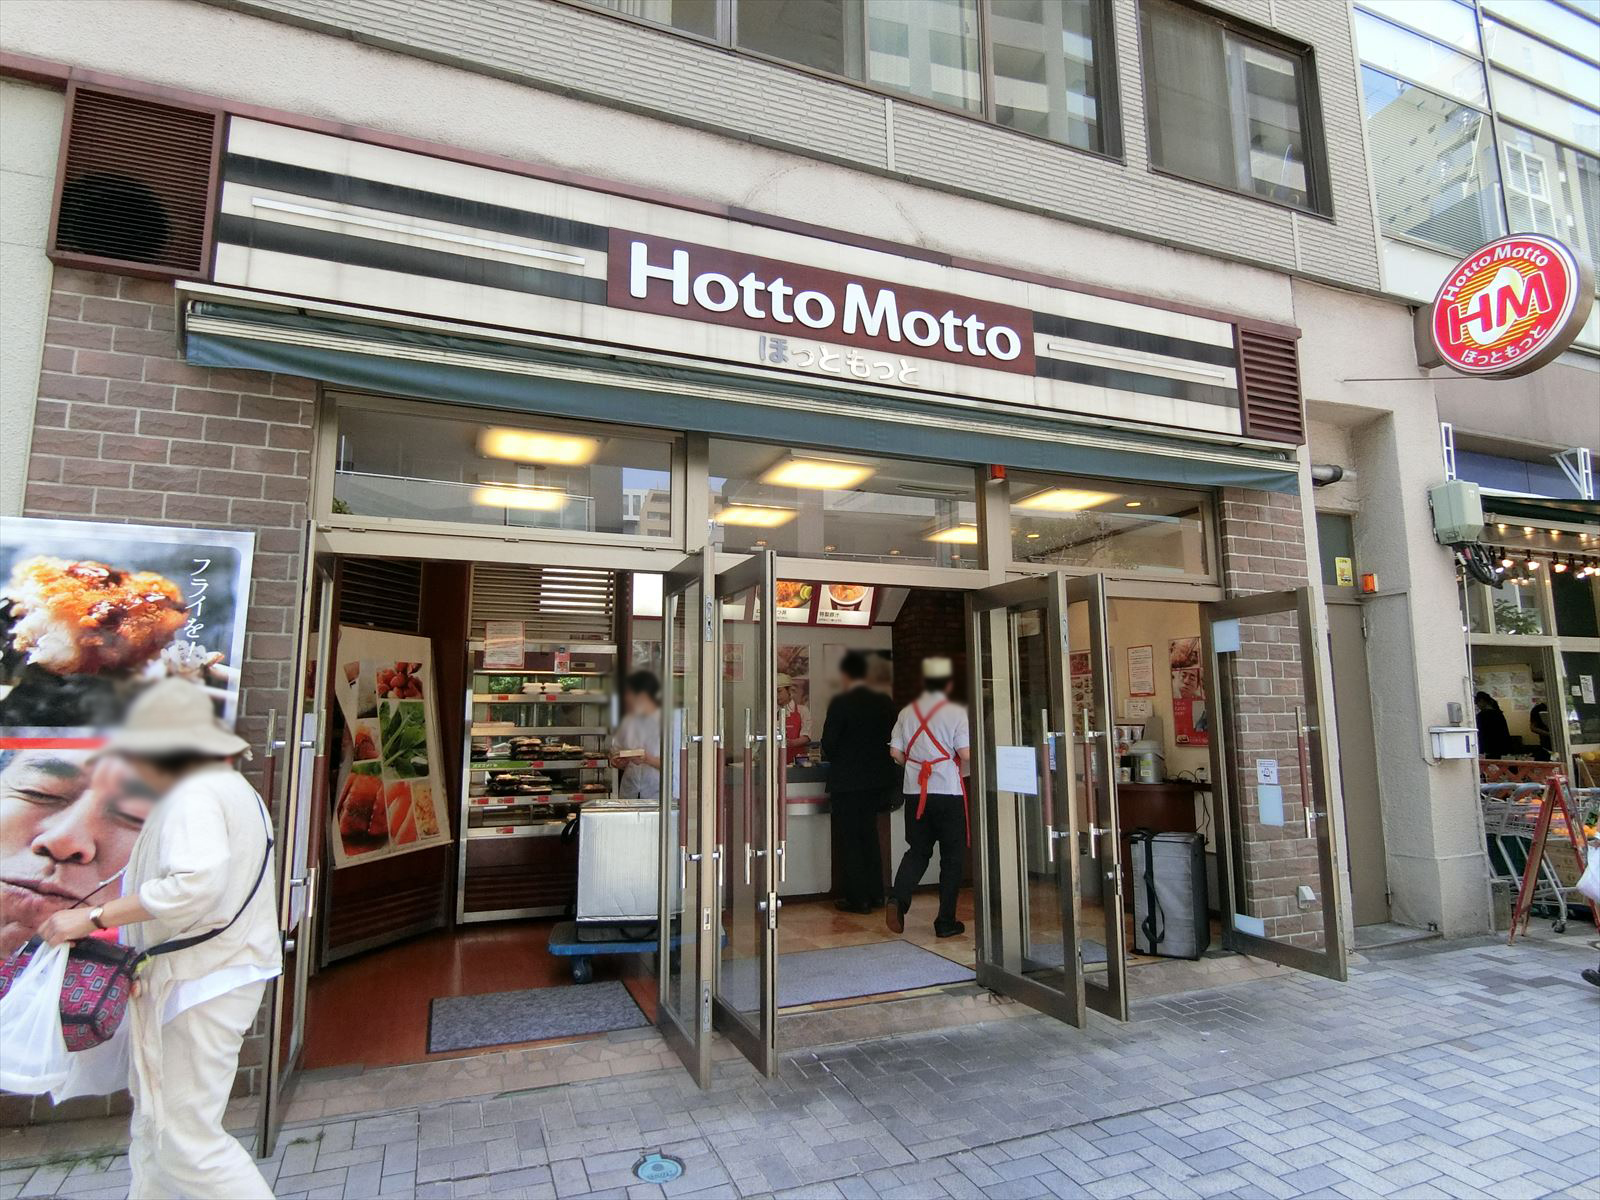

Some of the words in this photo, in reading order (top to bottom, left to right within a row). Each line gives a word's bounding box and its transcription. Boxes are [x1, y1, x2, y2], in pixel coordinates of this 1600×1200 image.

[1442, 255, 1491, 302] Hotto
[1493, 244, 1549, 267] Motto
[629, 241, 836, 329] Hotto
[842, 283, 1022, 361] Motto
[758, 335, 920, 385] ほっともっと
[1461, 325, 1547, 364] ほっともっと
